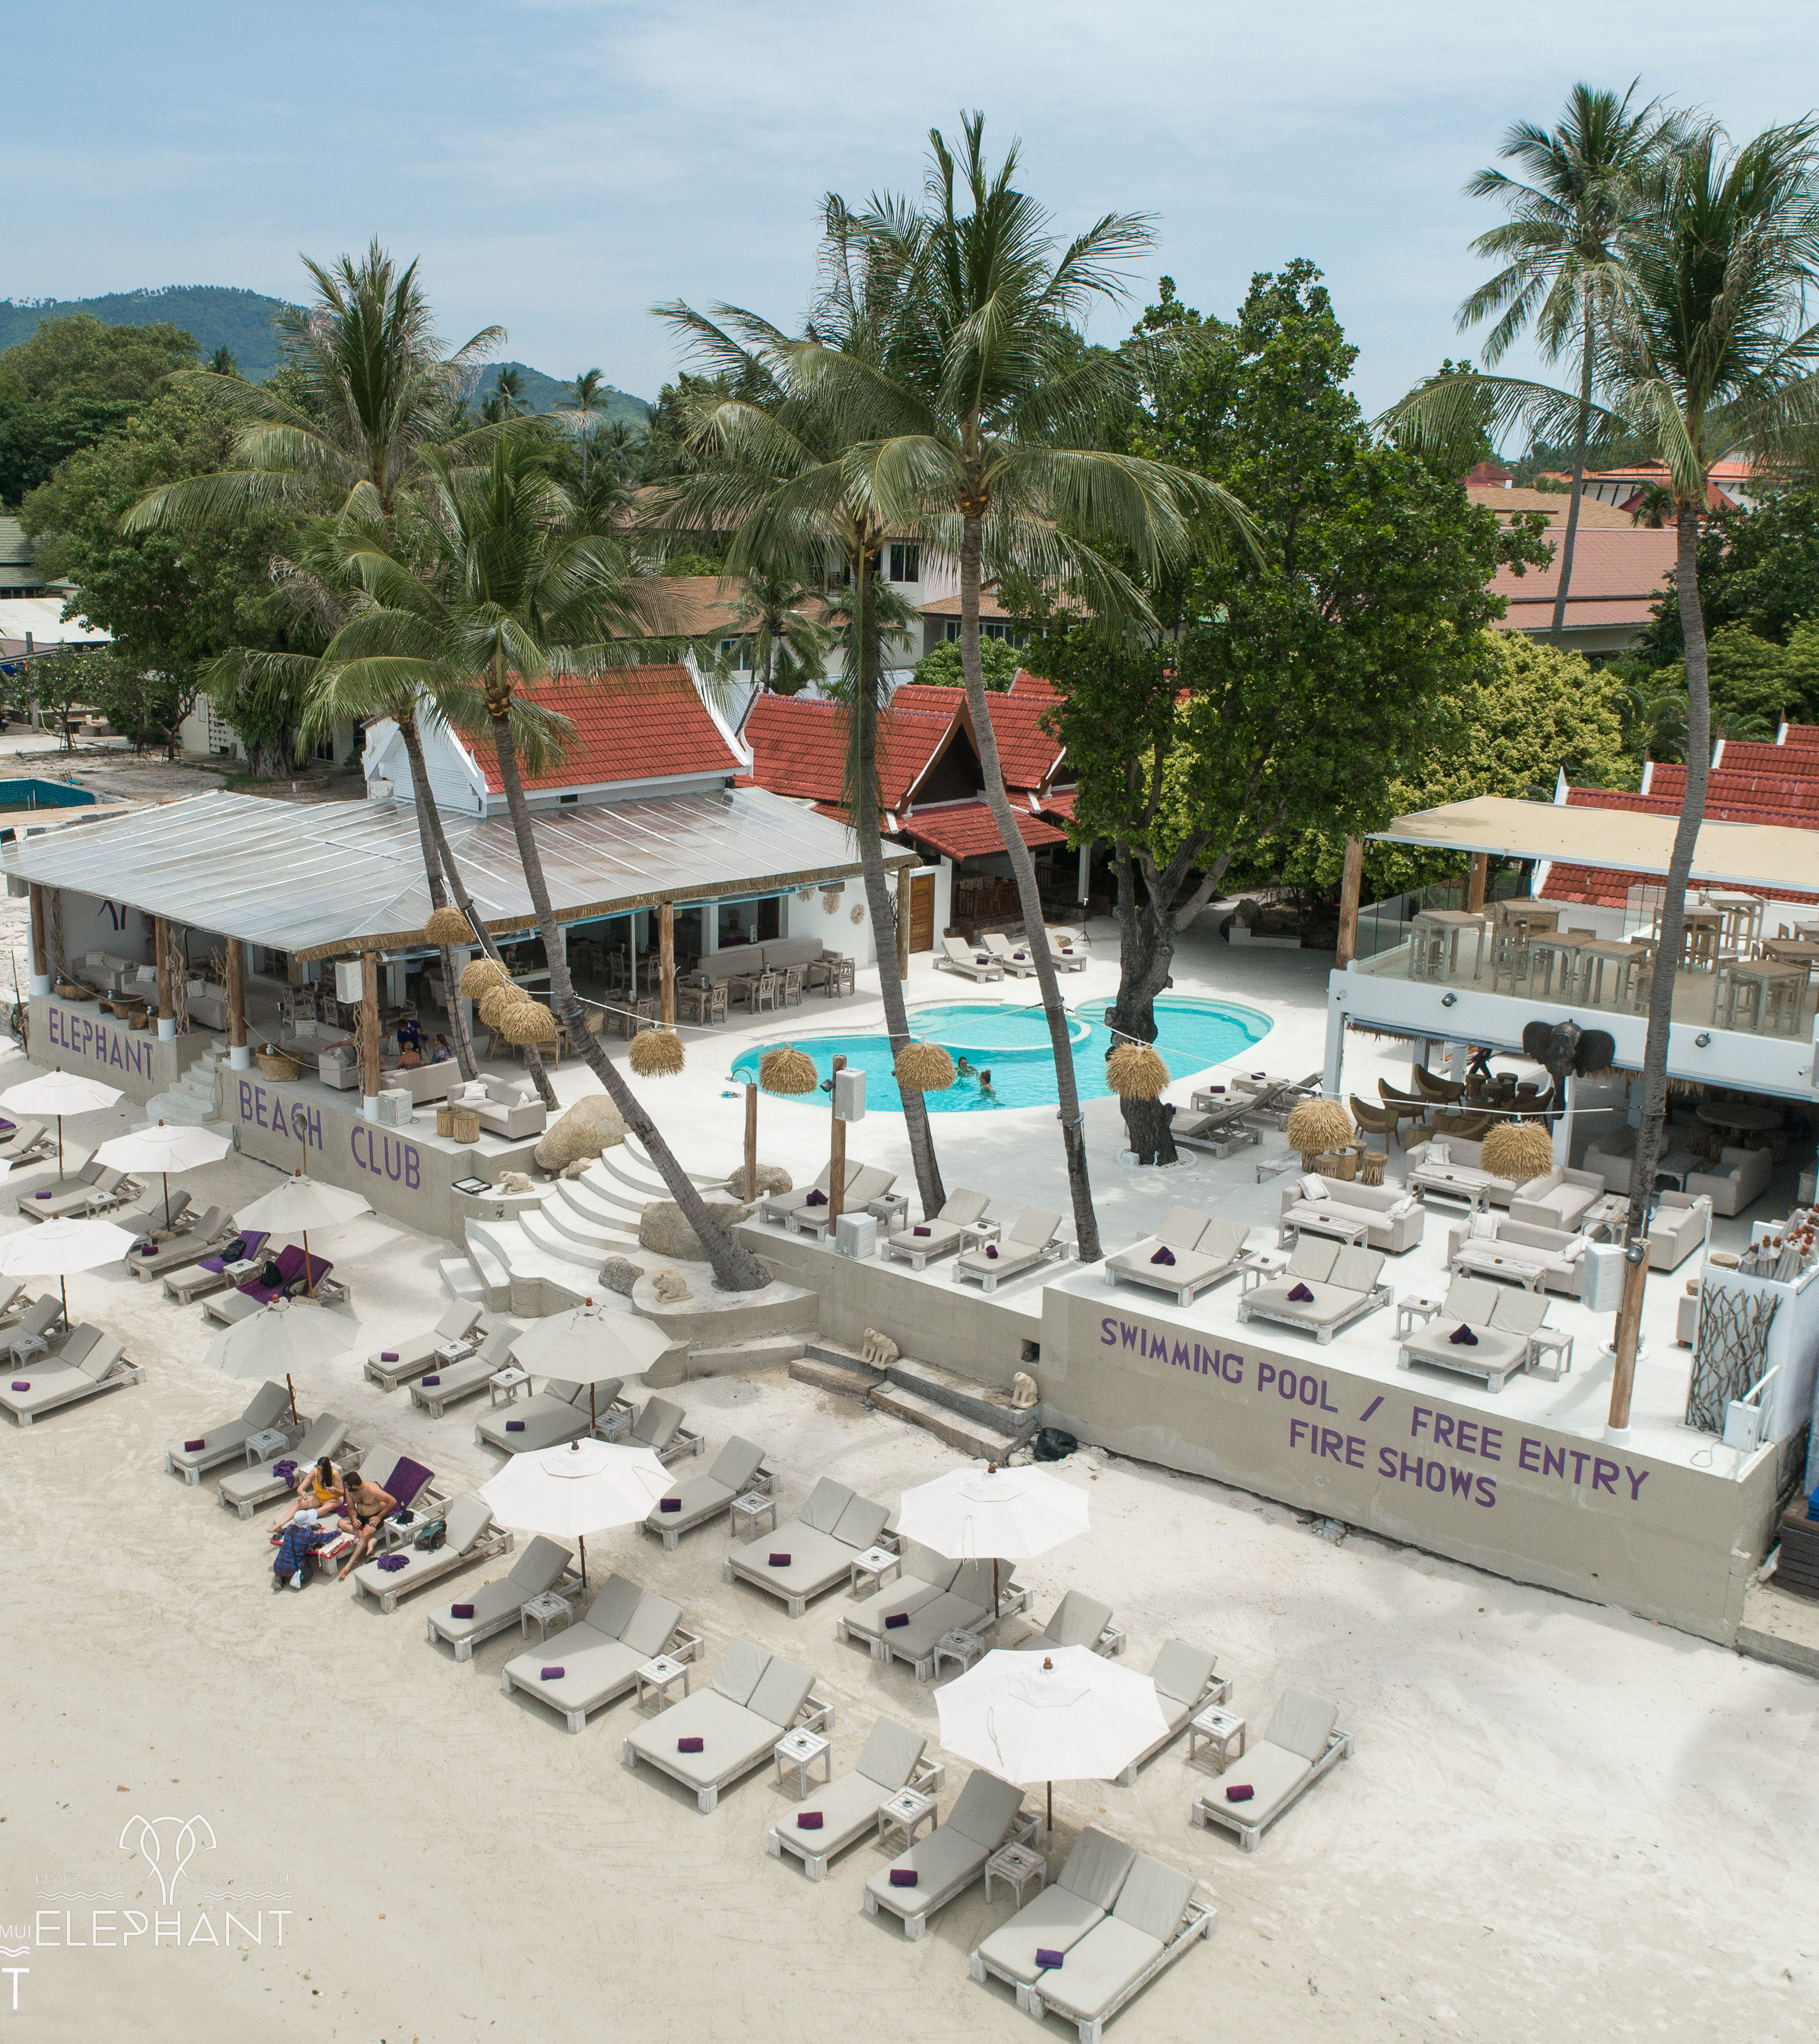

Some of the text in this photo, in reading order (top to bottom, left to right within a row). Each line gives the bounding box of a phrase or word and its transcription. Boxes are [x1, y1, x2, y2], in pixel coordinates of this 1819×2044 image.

[49, 1007, 154, 1081] ELEPHANT
[239, 1080, 421, 1190] BEACH CLUB
[1101, 1318, 1650, 1501] SWIMMING POOL / FREE ENTRY
[1290, 1418, 1497, 1508] FIRE SHOWS
